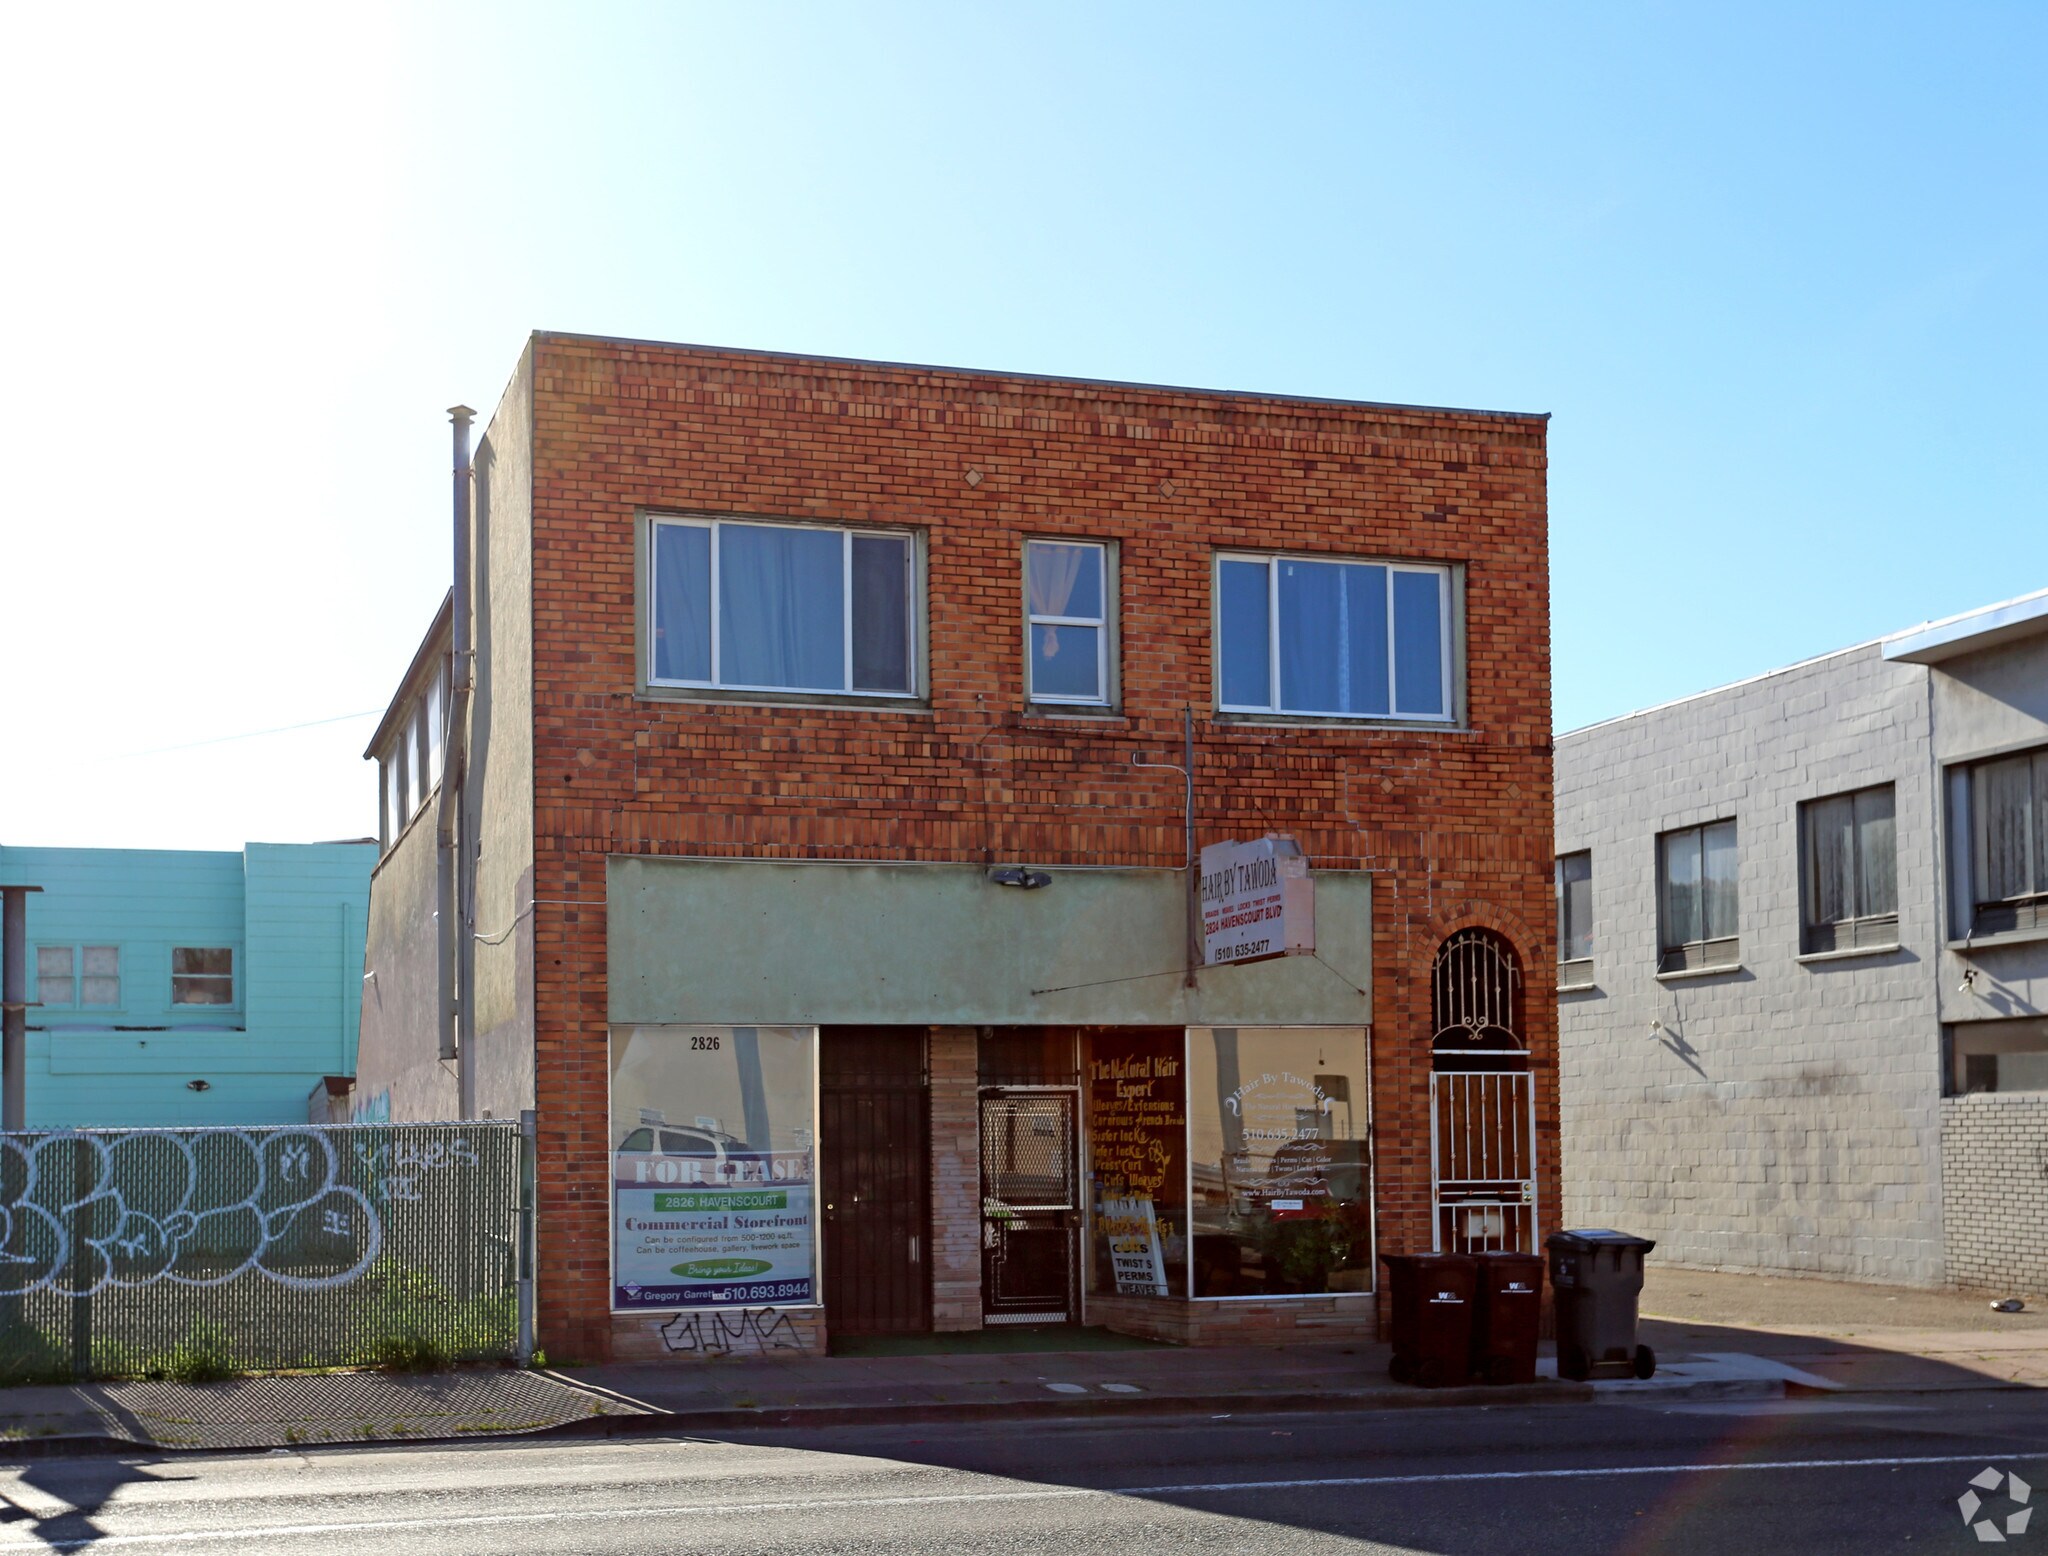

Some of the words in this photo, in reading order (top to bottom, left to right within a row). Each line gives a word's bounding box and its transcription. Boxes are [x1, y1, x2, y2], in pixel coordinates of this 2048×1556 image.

[1202, 872, 1223, 902] HAIR
[1224, 862, 1237, 896] BY
[1238, 857, 1277, 892] TAWODA
[1205, 921, 1219, 935] 2824
[1220, 908, 1265, 930] HAVENSCOURT
[1265, 905, 1282, 920] BLVD
[1215, 946, 1233, 961] (510)
[1235, 939, 1270, 957] 635-2477
[691, 1036, 720, 1050] 2826
[1116, 1080, 1155, 1101] Expert
[1233, 1078, 1260, 1100] Hair
[1263, 1073, 1278, 1085] By
[1281, 1072, 1325, 1100] Tawoda
[1242, 1127, 1319, 1141] 510.635.2477
[635, 1160, 702, 1184] FOR
[665, 1196, 695, 1208] 2826
[699, 1194, 778, 1208] HAVENSCOURT
[1242, 1188, 1326, 1198] www.HairByTawoda.com
[625, 1215, 729, 1231] Commercial
[733, 1213, 808, 1229] Storefront
[645, 1236, 661, 1244] Can
[663, 1235, 674, 1244] be
[677, 1235, 718, 1245] configured
[721, 1233, 739, 1243] from
[741, 1232, 776, 1242] 500-1200
[636, 1246, 652, 1254] Can
[655, 1245, 666, 1254] be
[781, 1241, 800, 1250] space
[687, 1260, 711, 1276] Bring
[1117, 1271, 1154, 1281] PERMS
[644, 1291, 681, 1302] Gregory
[684, 1289, 715, 1300] Garrett
[724, 1282, 809, 1301] 510.693.8944
[1120, 1284, 1158, 1295] WEAVES
